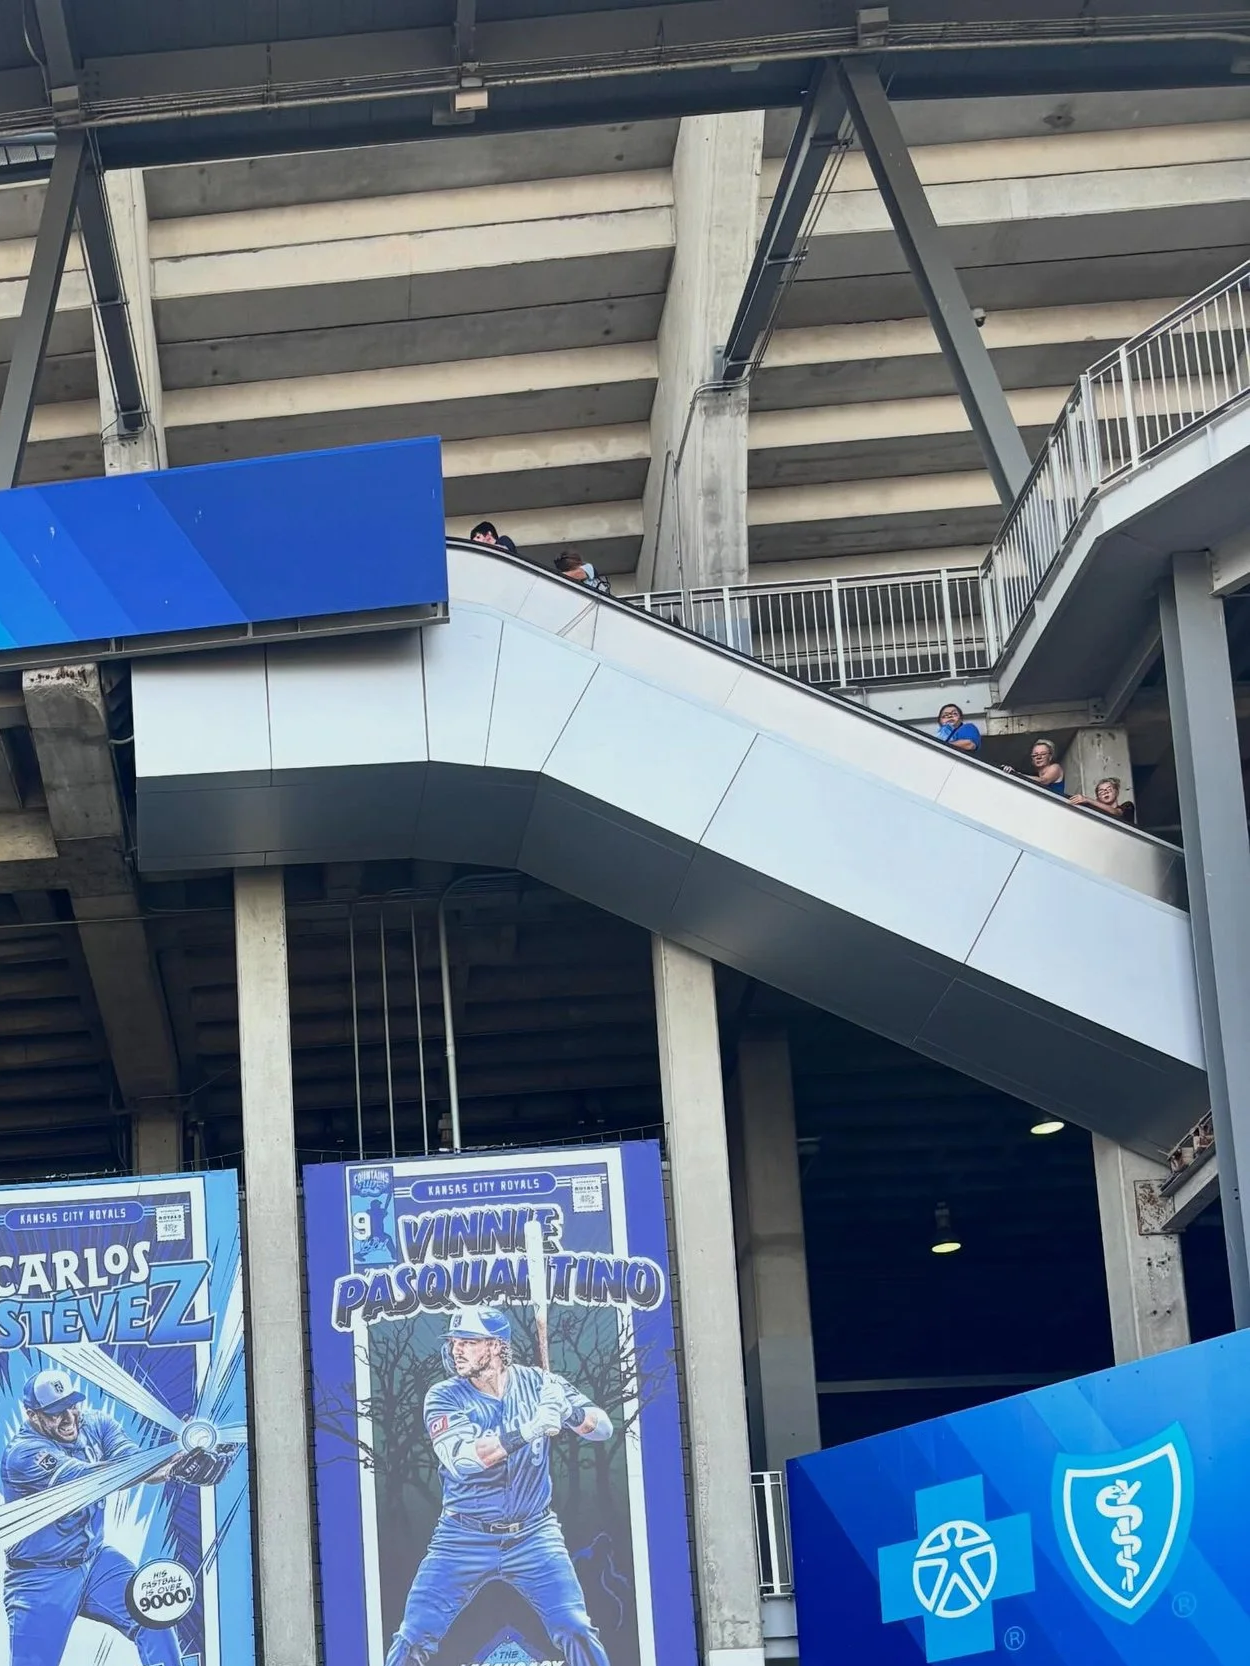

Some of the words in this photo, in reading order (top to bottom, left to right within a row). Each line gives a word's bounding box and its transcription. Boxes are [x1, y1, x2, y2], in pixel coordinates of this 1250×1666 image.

[428, 1183, 468, 1196] KANSAS
[473, 1181, 495, 1194] CITY
[500, 1178, 540, 1191] ROYALS
[20, 1212, 58, 1225] KANSAS
[63, 1210, 83, 1222] CITY
[90, 1208, 126, 1220] ROYALS
[352, 1212, 372, 1240] 9
[399, 1205, 563, 1265] VINNIE
[333, 1251, 664, 1330] PASQUANTINO
[141, 1575, 183, 1590] FASTBALL
[153, 1570, 168, 1580] HIS
[146, 1588, 154, 1597] IS
[157, 1583, 182, 1594] OVER
[140, 1589, 192, 1613] 9000!
[500, 1651, 518, 1659] THE
